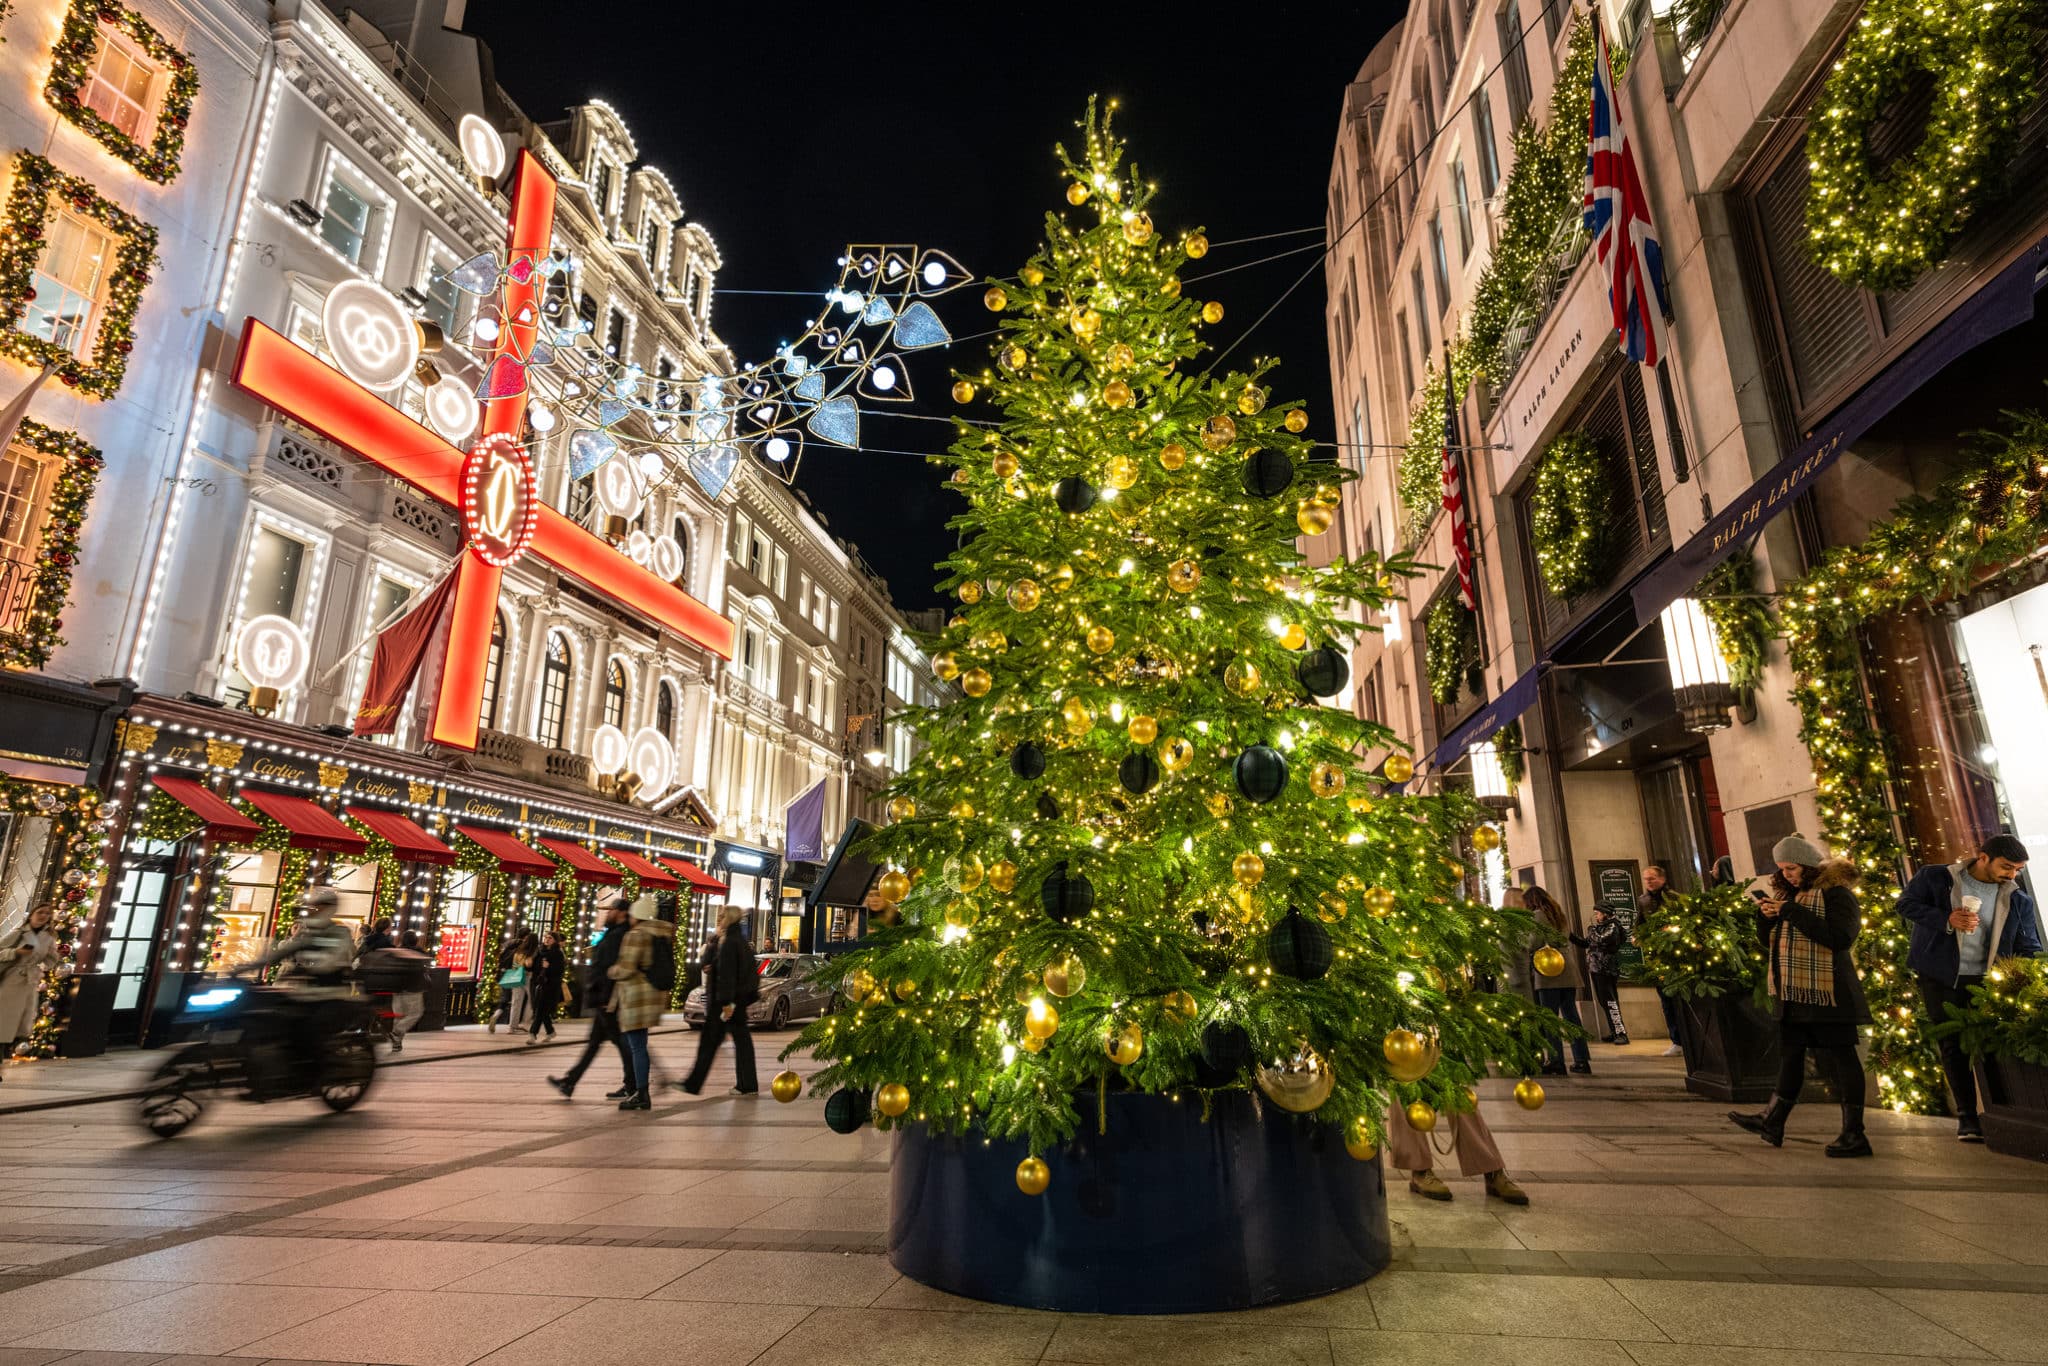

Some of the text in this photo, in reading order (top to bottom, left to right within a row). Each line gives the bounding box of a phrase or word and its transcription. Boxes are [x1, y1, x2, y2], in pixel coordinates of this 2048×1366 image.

[1523, 328, 1582, 427] RALPH LAUREN
[1712, 431, 1844, 554] RALPH LAUREN
[64, 747, 83, 758] 178
[169, 746, 191, 759] 177
[252, 757, 305, 780] Cartier
[355, 776, 398, 797] Cartier
[464, 798, 504, 817] Cartier
[543, 813, 575, 831] Cartier
[607, 826, 635, 842] Cartier
[662, 837, 686, 851] Cartier
